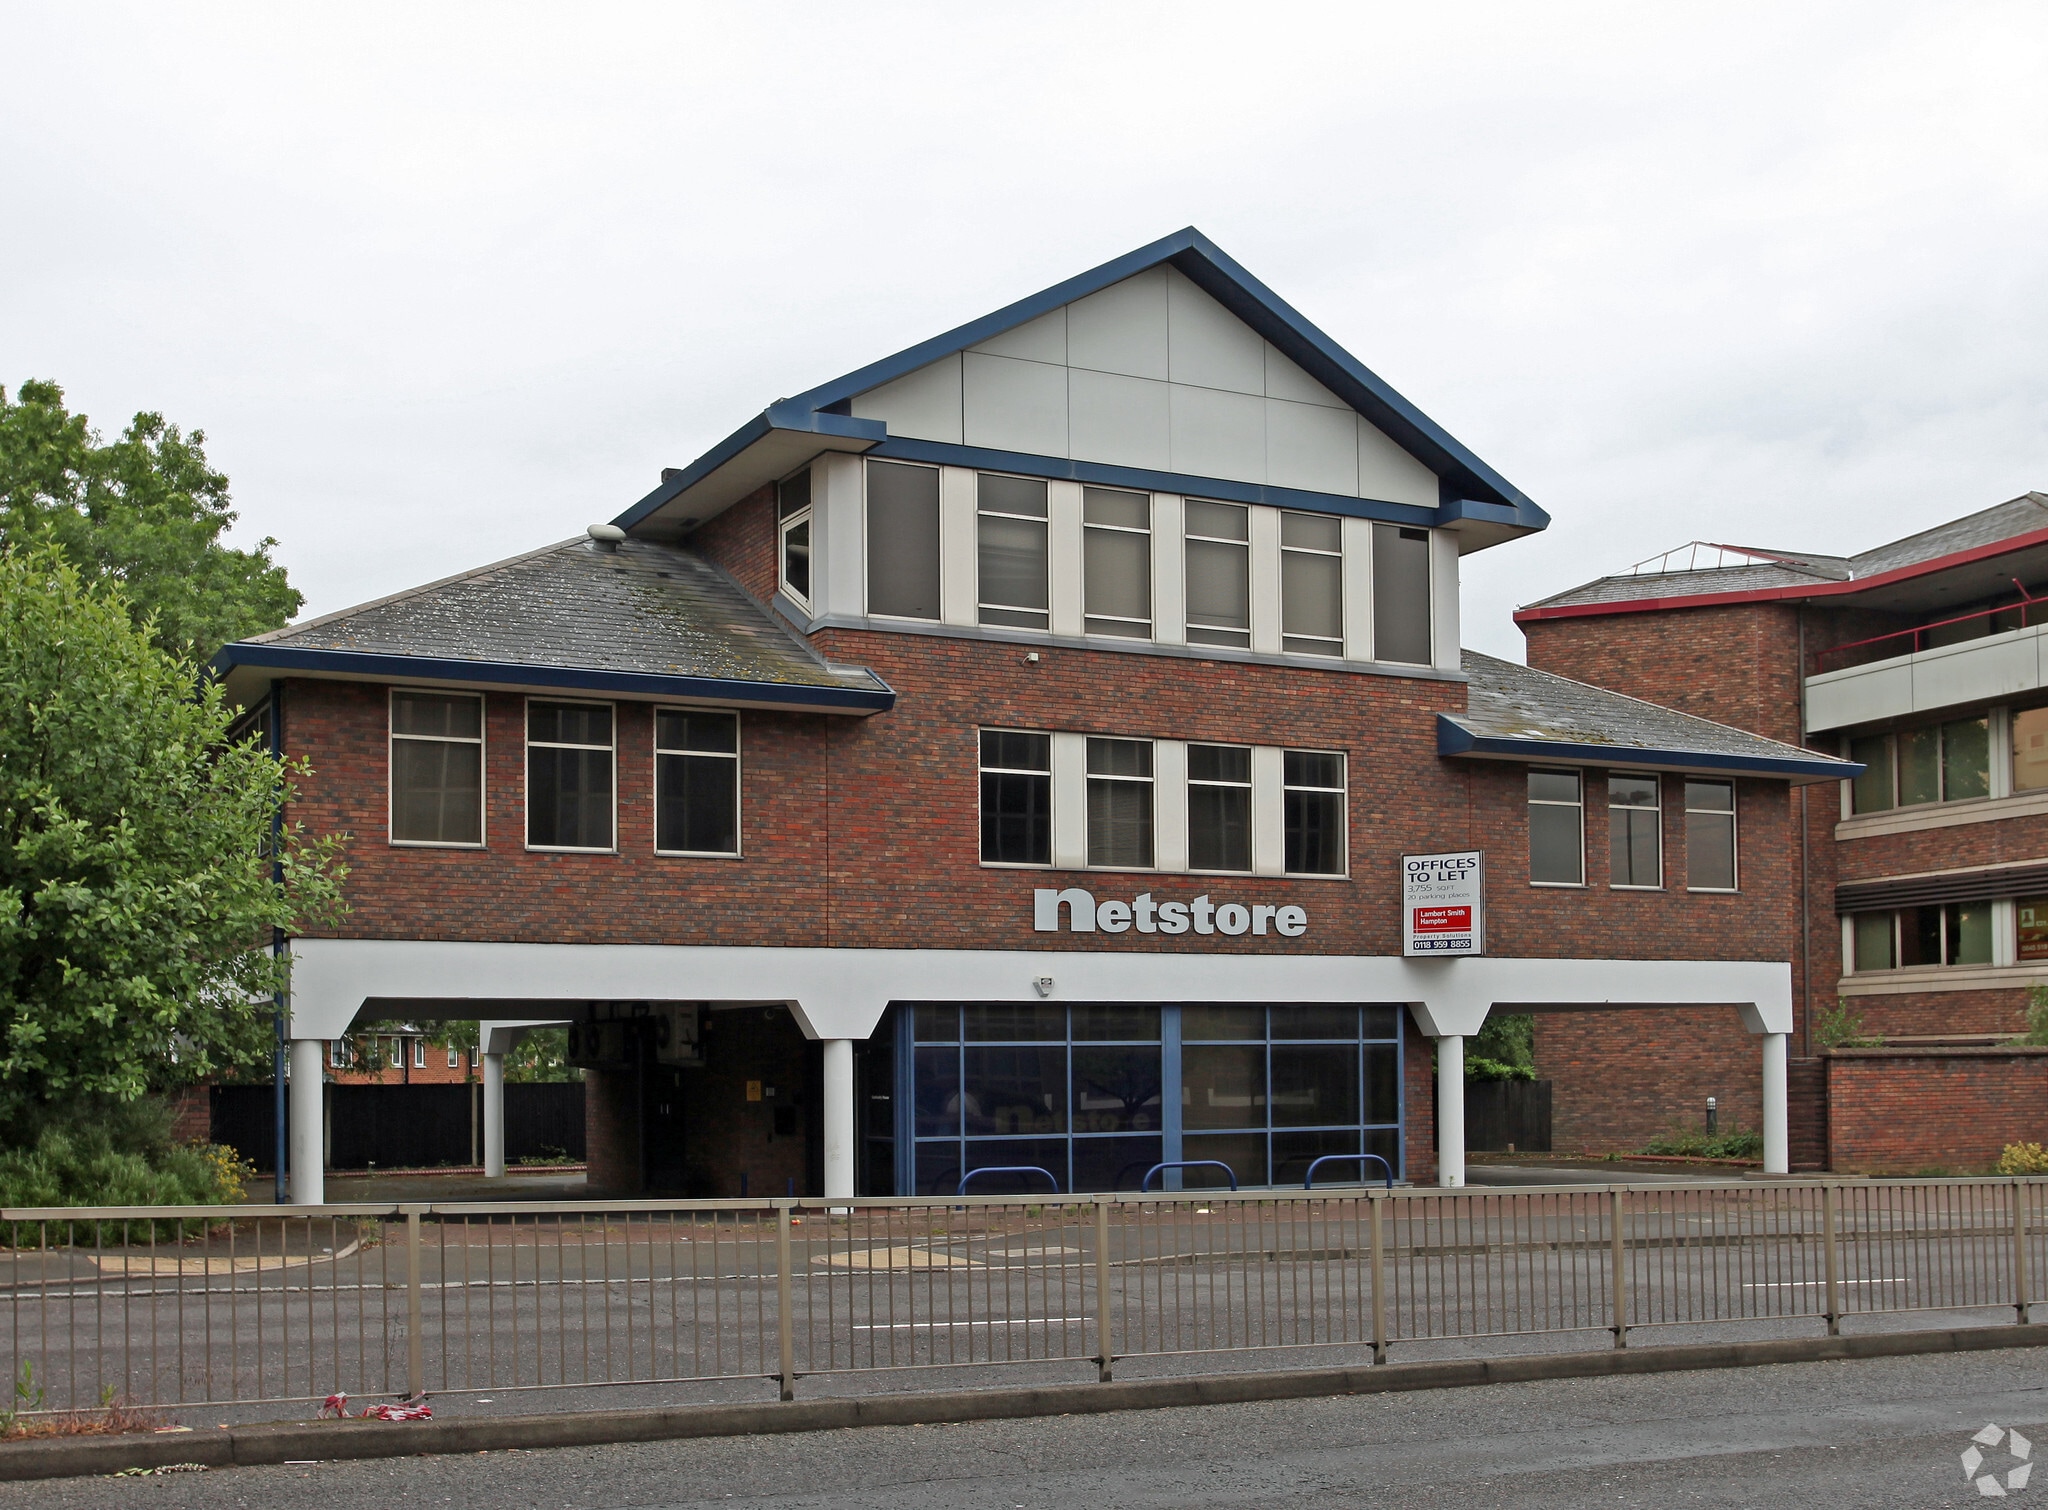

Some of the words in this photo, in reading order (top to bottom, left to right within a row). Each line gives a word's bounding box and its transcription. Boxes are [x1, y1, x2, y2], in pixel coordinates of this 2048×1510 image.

[1407, 858, 1476, 872] OFFICES
[1407, 872, 1430, 883] TO
[1438, 870, 1469, 882] LET
[1408, 884, 1432, 893] 3,755
[1034, 887, 1307, 937] netstore
[1420, 910, 1446, 918] Lambert
[1447, 909, 1465, 917] Smith
[1420, 918, 1448, 926] Hampton
[1414, 941, 1431, 949] 0118
[1433, 941, 1448, 949] 959
[1450, 940, 1470, 948] 8855
